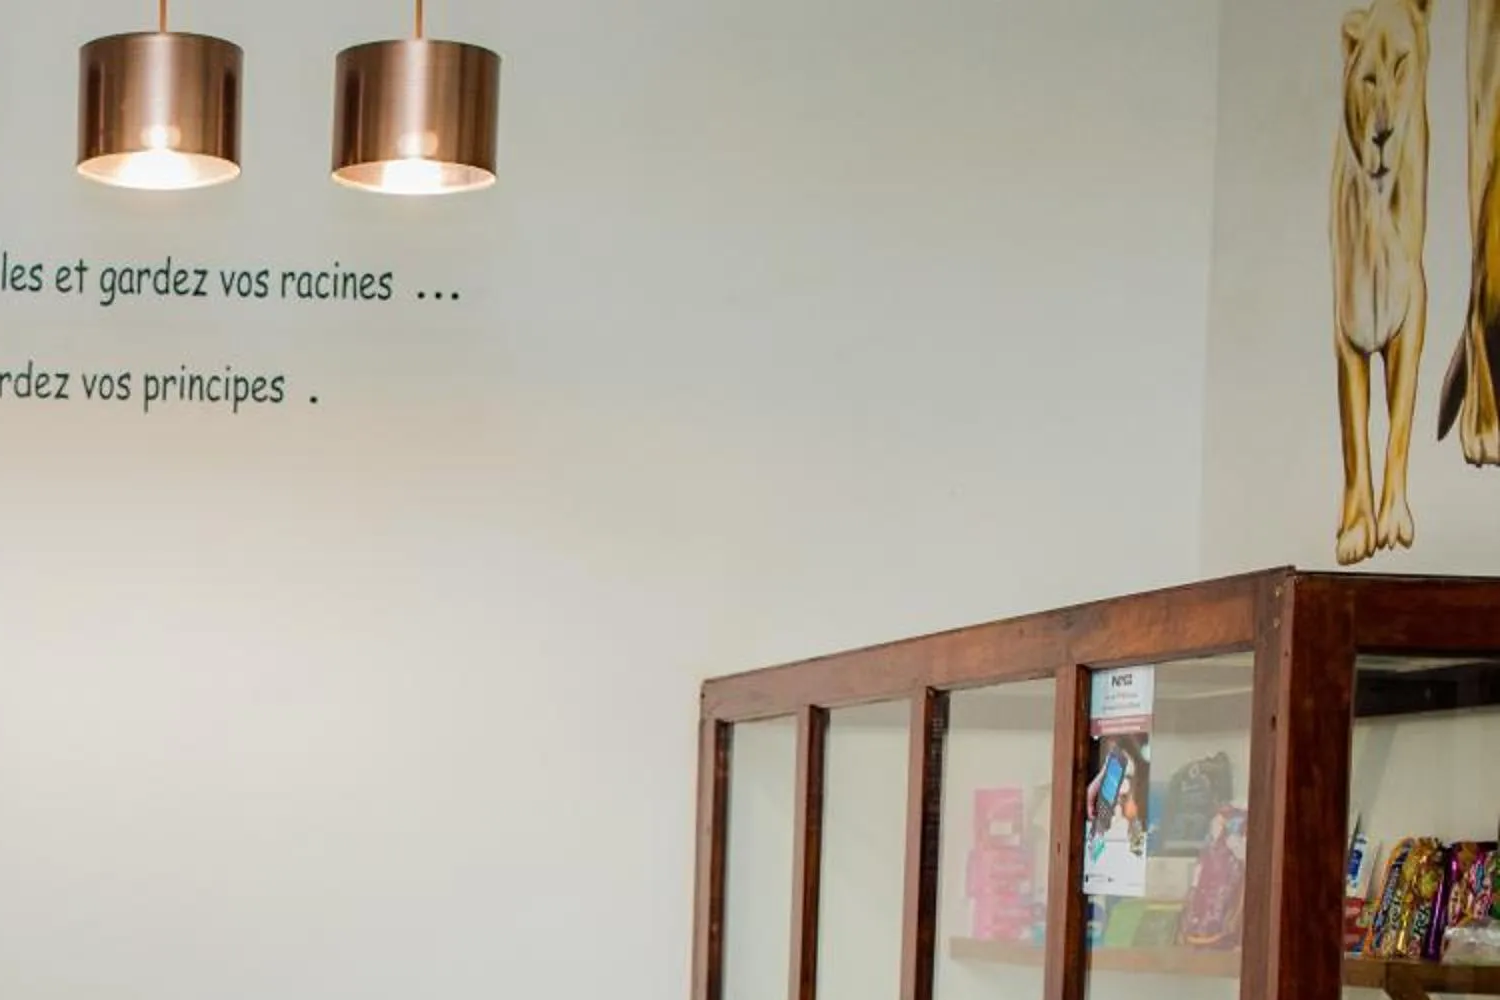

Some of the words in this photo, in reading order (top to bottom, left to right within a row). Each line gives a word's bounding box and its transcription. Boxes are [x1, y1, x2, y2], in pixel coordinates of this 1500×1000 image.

[55, 258, 89, 294] et
[99, 255, 209, 308] gardez
[219, 268, 270, 299] vos
[280, 261, 393, 302] racines
[81, 371, 132, 401] vos
[143, 364, 285, 414] principes
